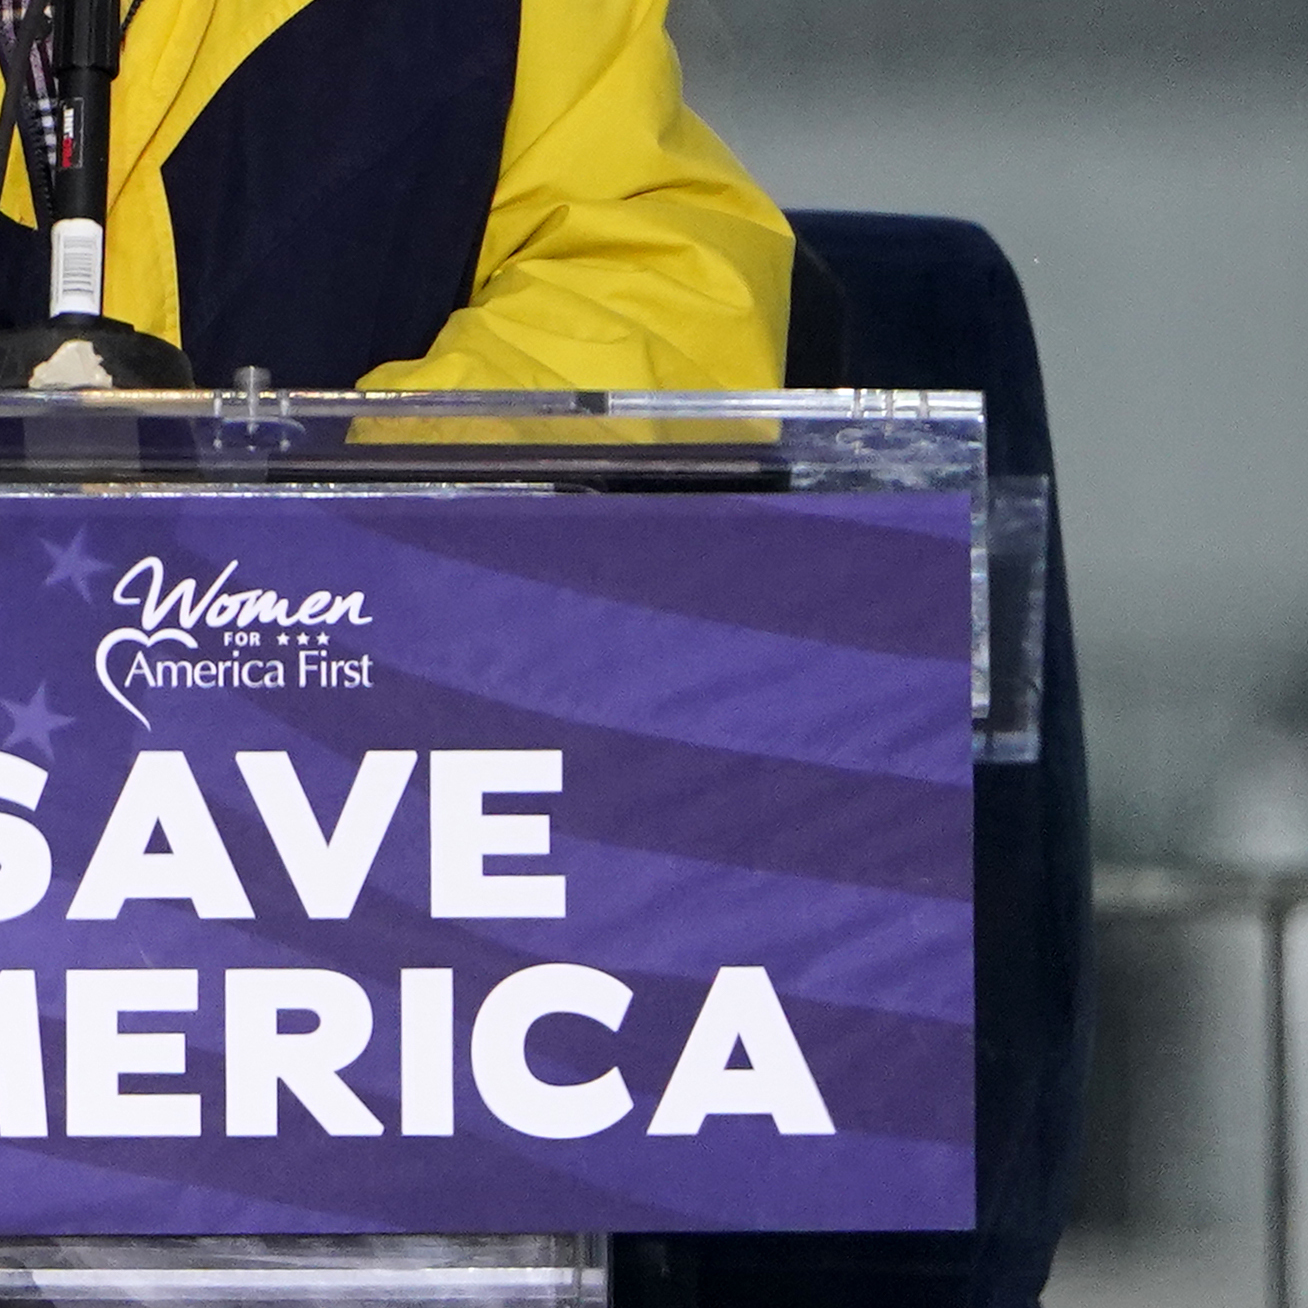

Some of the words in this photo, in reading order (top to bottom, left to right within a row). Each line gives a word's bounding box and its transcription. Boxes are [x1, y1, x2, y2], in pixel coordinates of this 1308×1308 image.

[112, 556, 373, 632] Women
[223, 631, 261, 647] FOR
[124, 649, 285, 689] America
[298, 649, 374, 689] First
